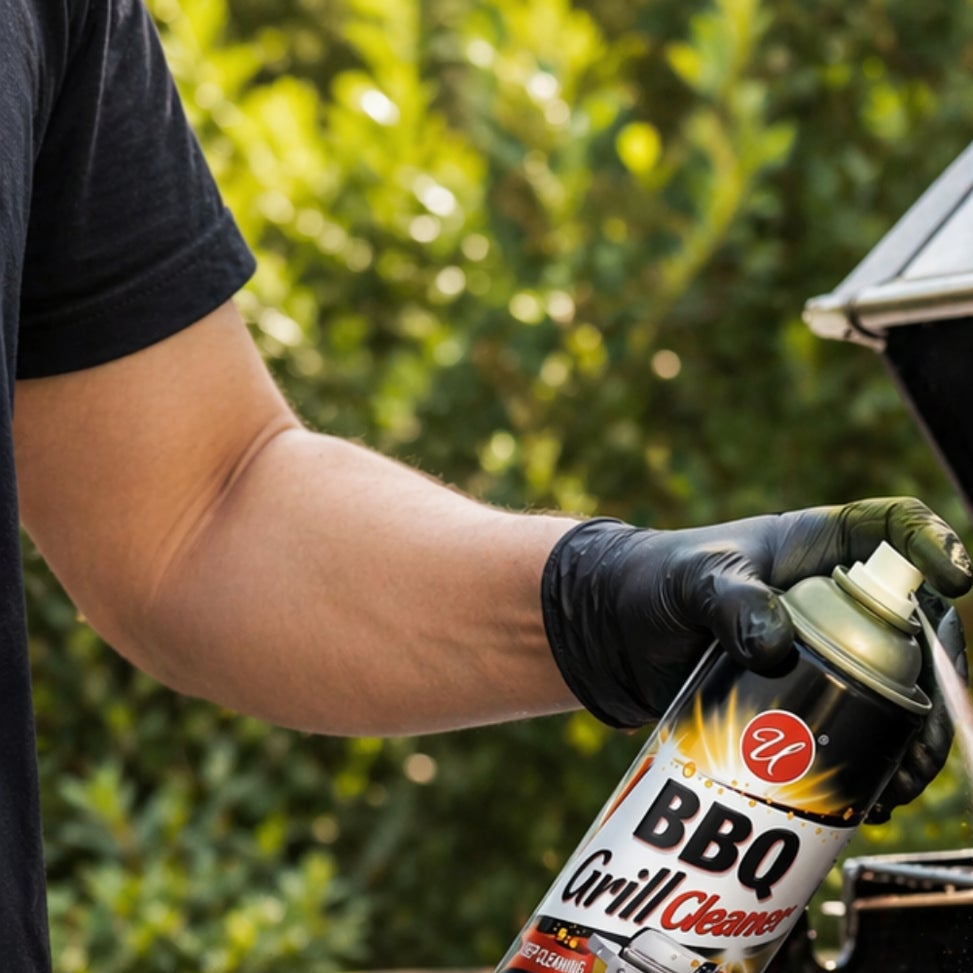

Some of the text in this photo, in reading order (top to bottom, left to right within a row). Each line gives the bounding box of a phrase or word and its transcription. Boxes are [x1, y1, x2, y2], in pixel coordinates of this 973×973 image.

[633, 778, 800, 901] BBQ
[561, 849, 799, 938] Grill Cleaner
